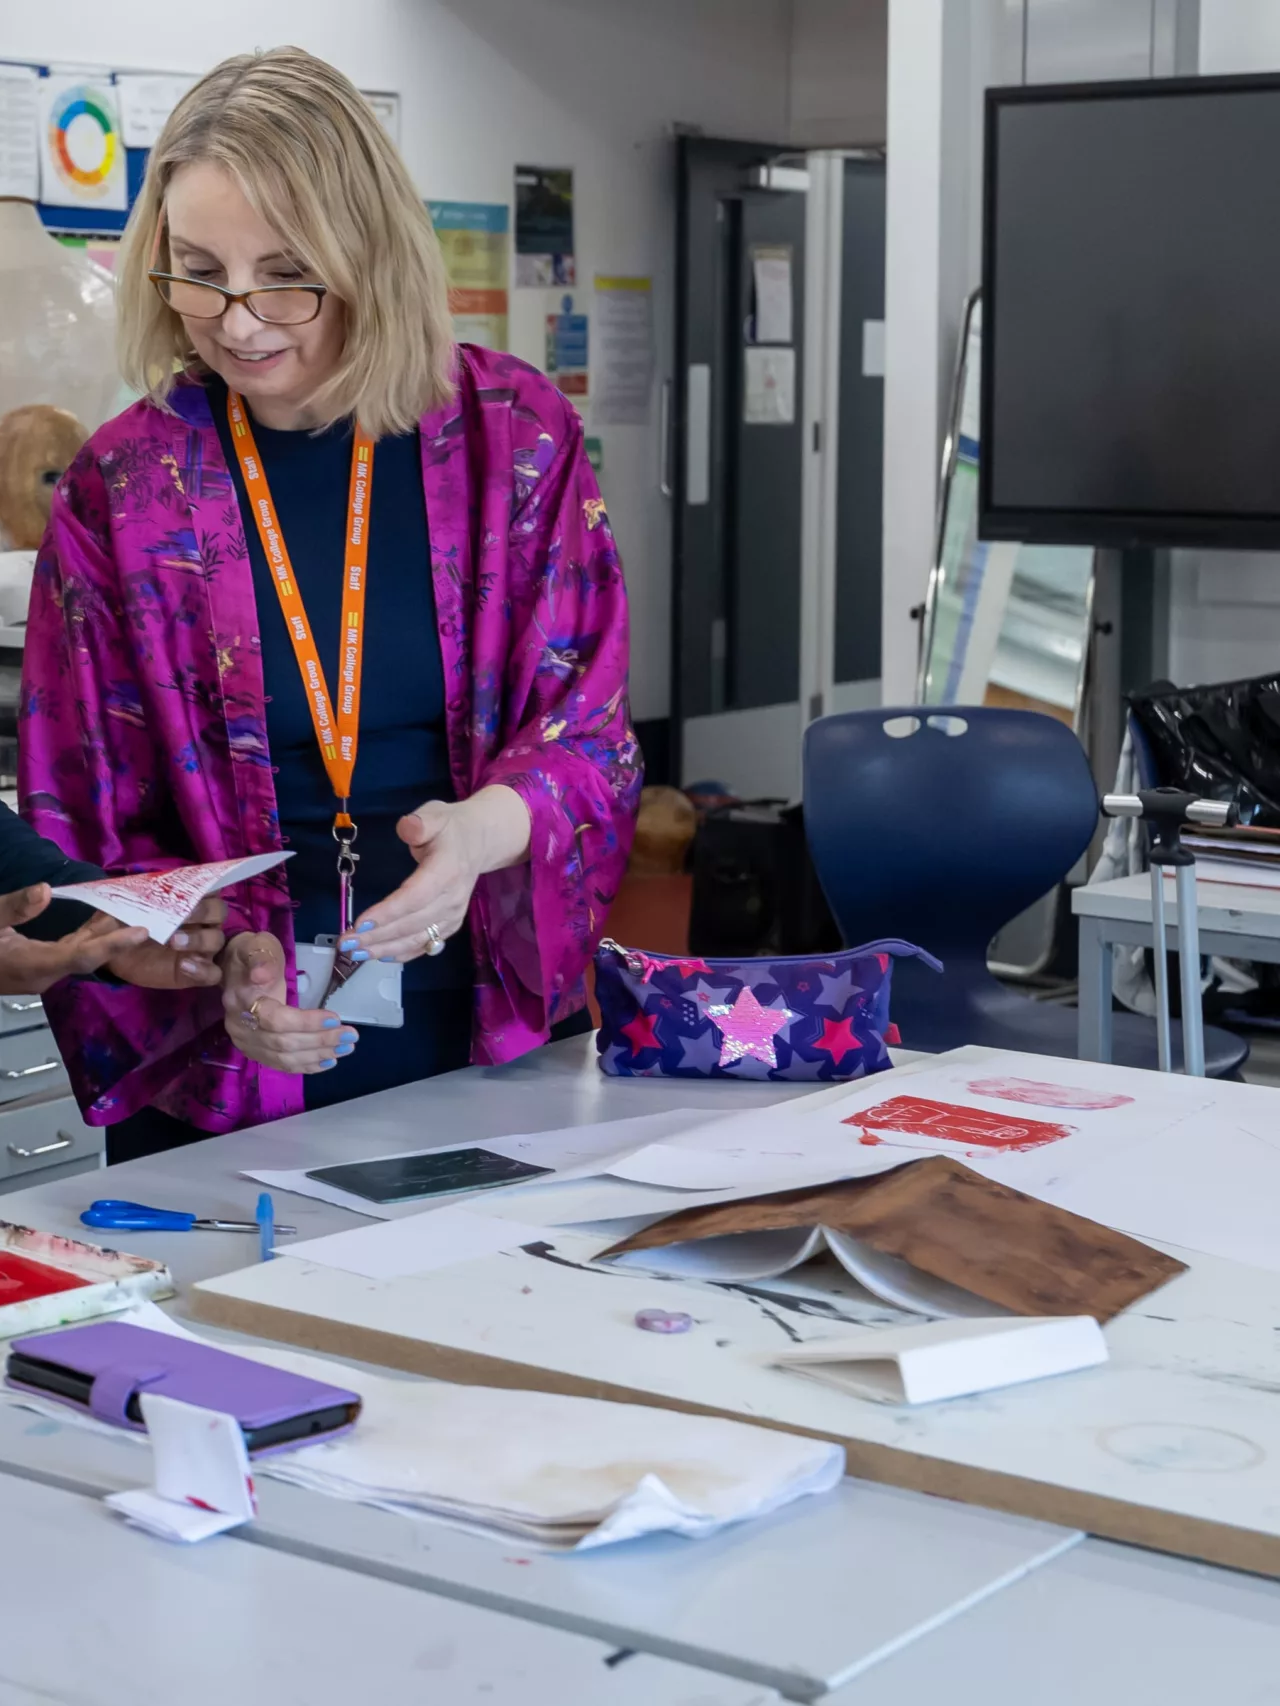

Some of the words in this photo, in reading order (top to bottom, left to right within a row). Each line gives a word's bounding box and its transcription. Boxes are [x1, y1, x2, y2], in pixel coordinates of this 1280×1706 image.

[244, 456, 259, 480] Staff
[357, 462, 368, 478] MK
[353, 480, 367, 515] College
[258, 499, 272, 528] Group
[351, 516, 364, 545] Group
[266, 528, 283, 563] College
[275, 563, 288, 580] MK
[349, 566, 362, 591] Staff
[290, 615, 307, 640] Staff
[347, 628, 358, 644] MK
[306, 659, 320, 689] Group
[343, 646, 357, 682] College
[314, 690, 330, 726] College
[342, 684, 355, 714] Group
[321, 727, 334, 744] MK
[341, 736, 353, 761] Staff
